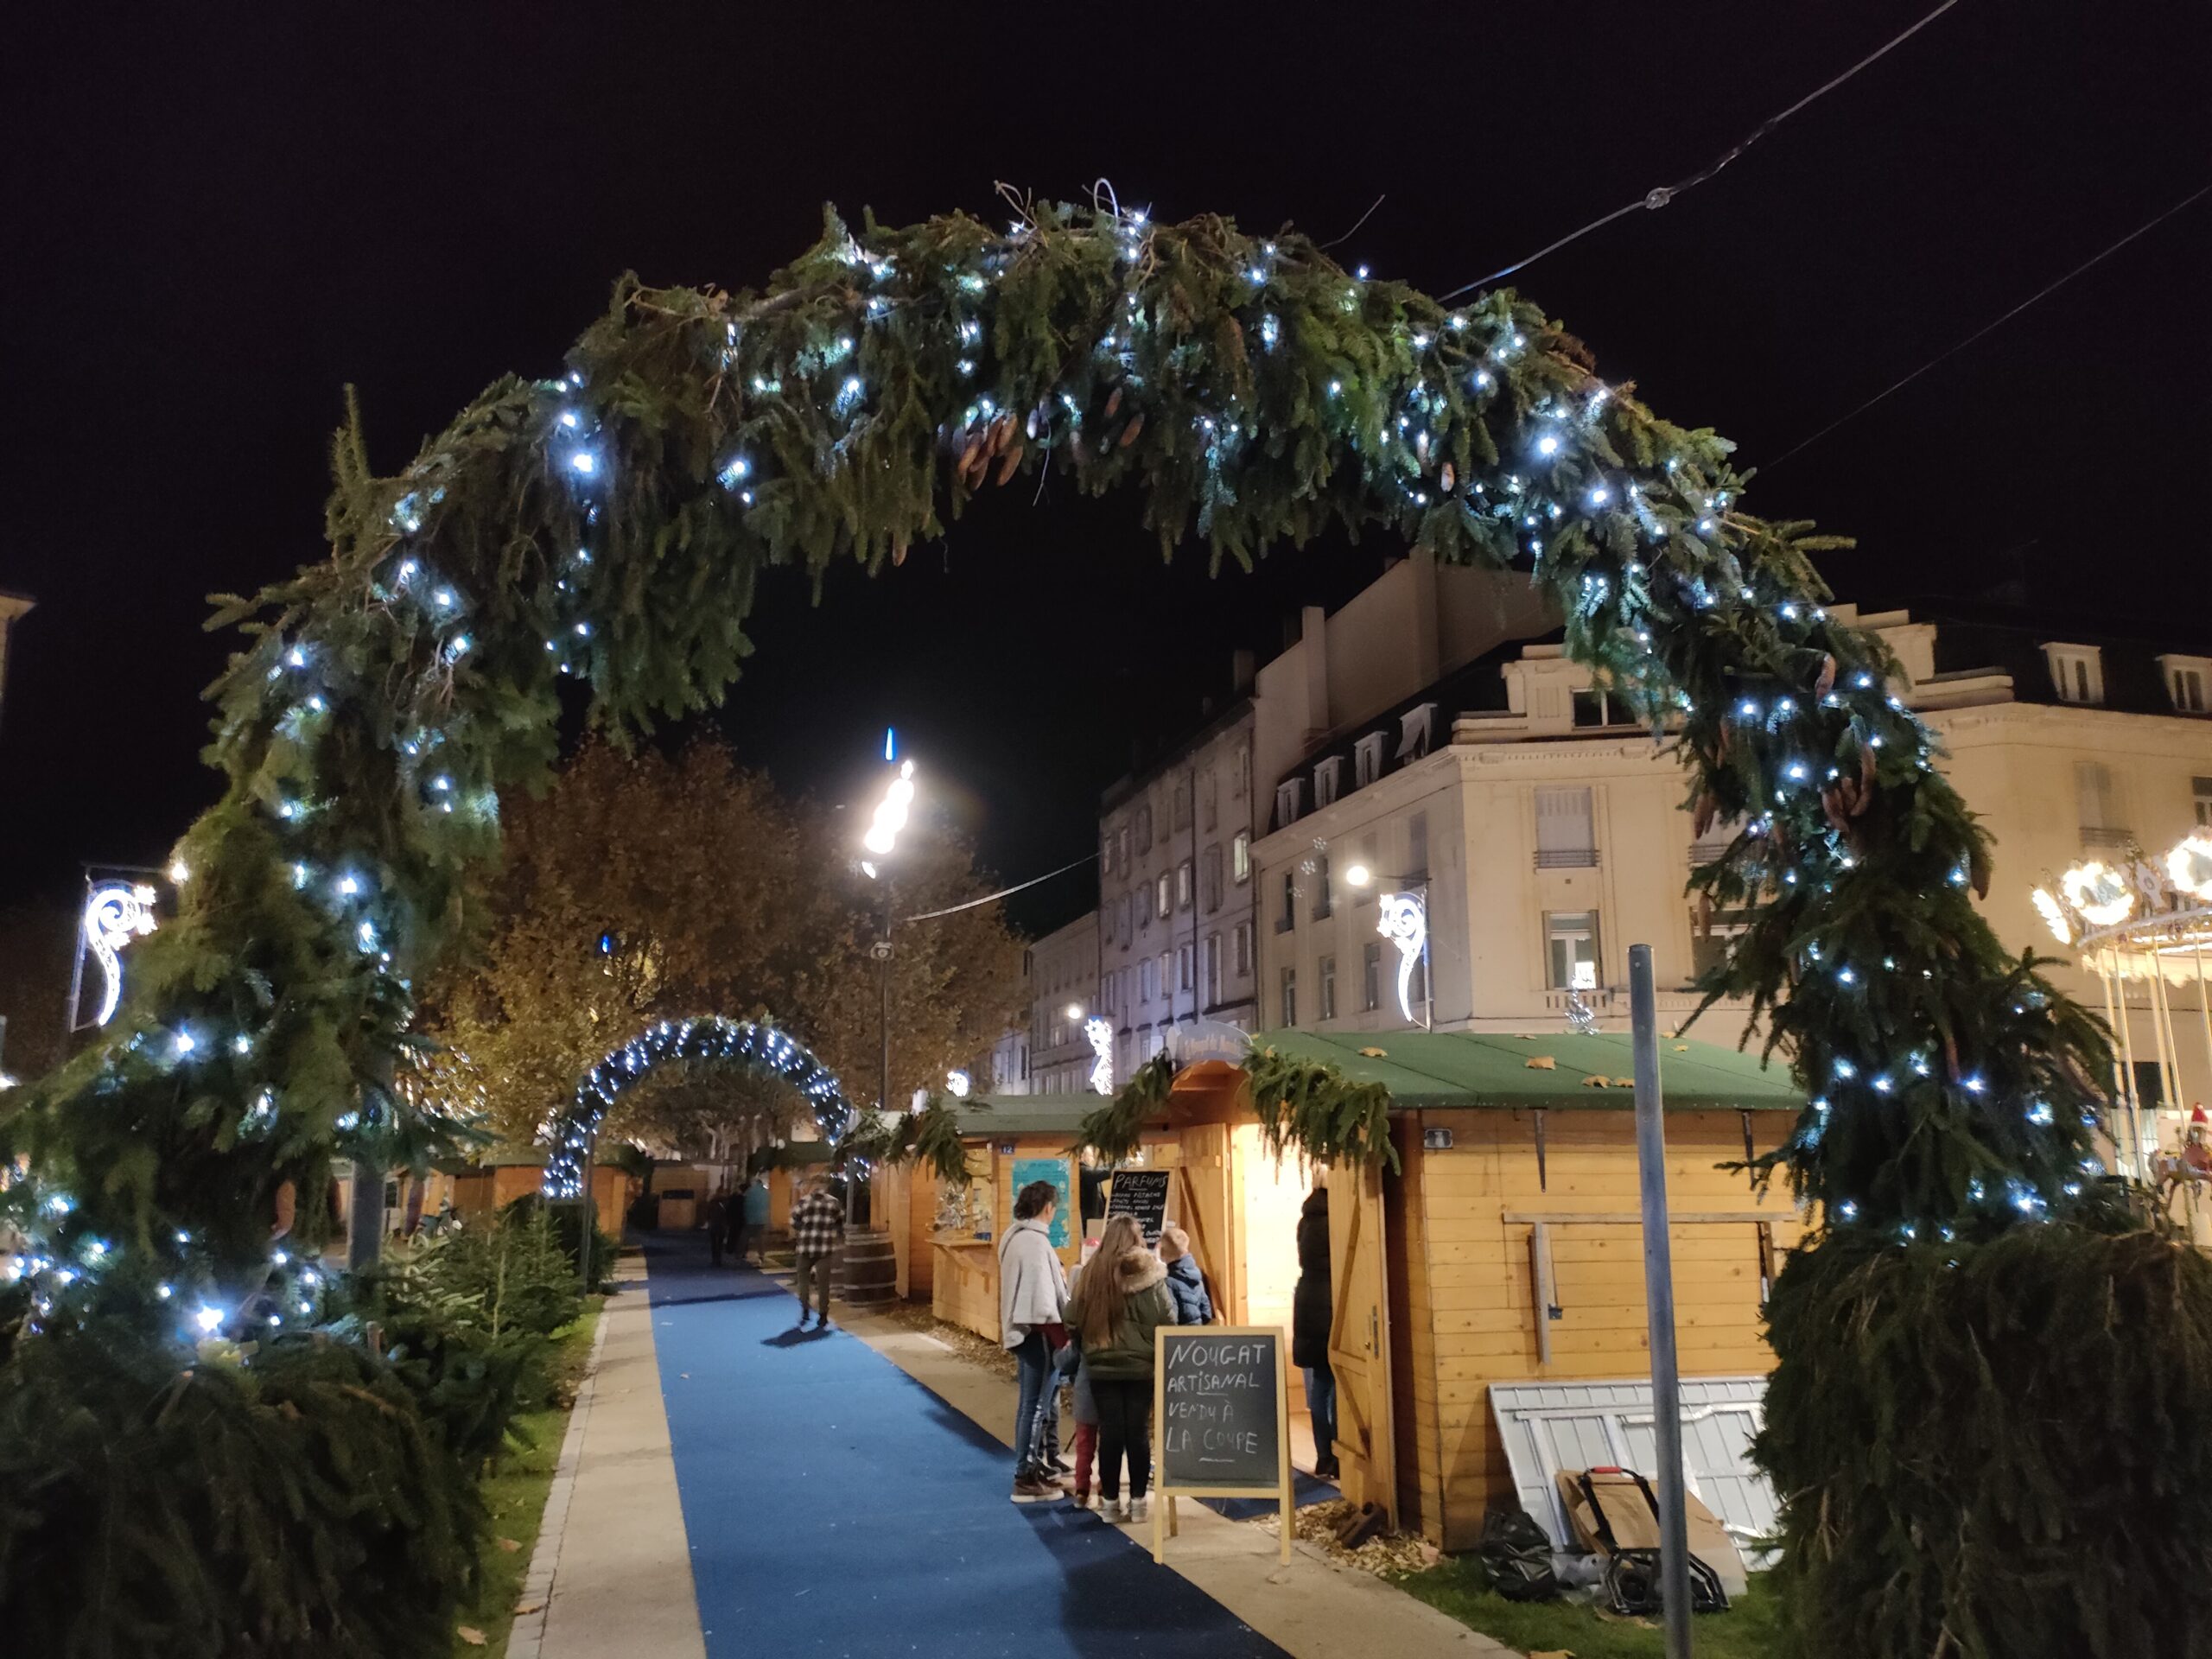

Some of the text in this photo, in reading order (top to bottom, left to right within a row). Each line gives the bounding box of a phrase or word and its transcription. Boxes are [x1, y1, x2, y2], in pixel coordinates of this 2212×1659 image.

[1114, 1173, 1168, 1189] PARFUMS
[1168, 1340, 1266, 1370] NOUGAT
[1168, 1400, 1234, 1422] VENDU À
[1166, 1427, 1258, 1454] LA COUPE
